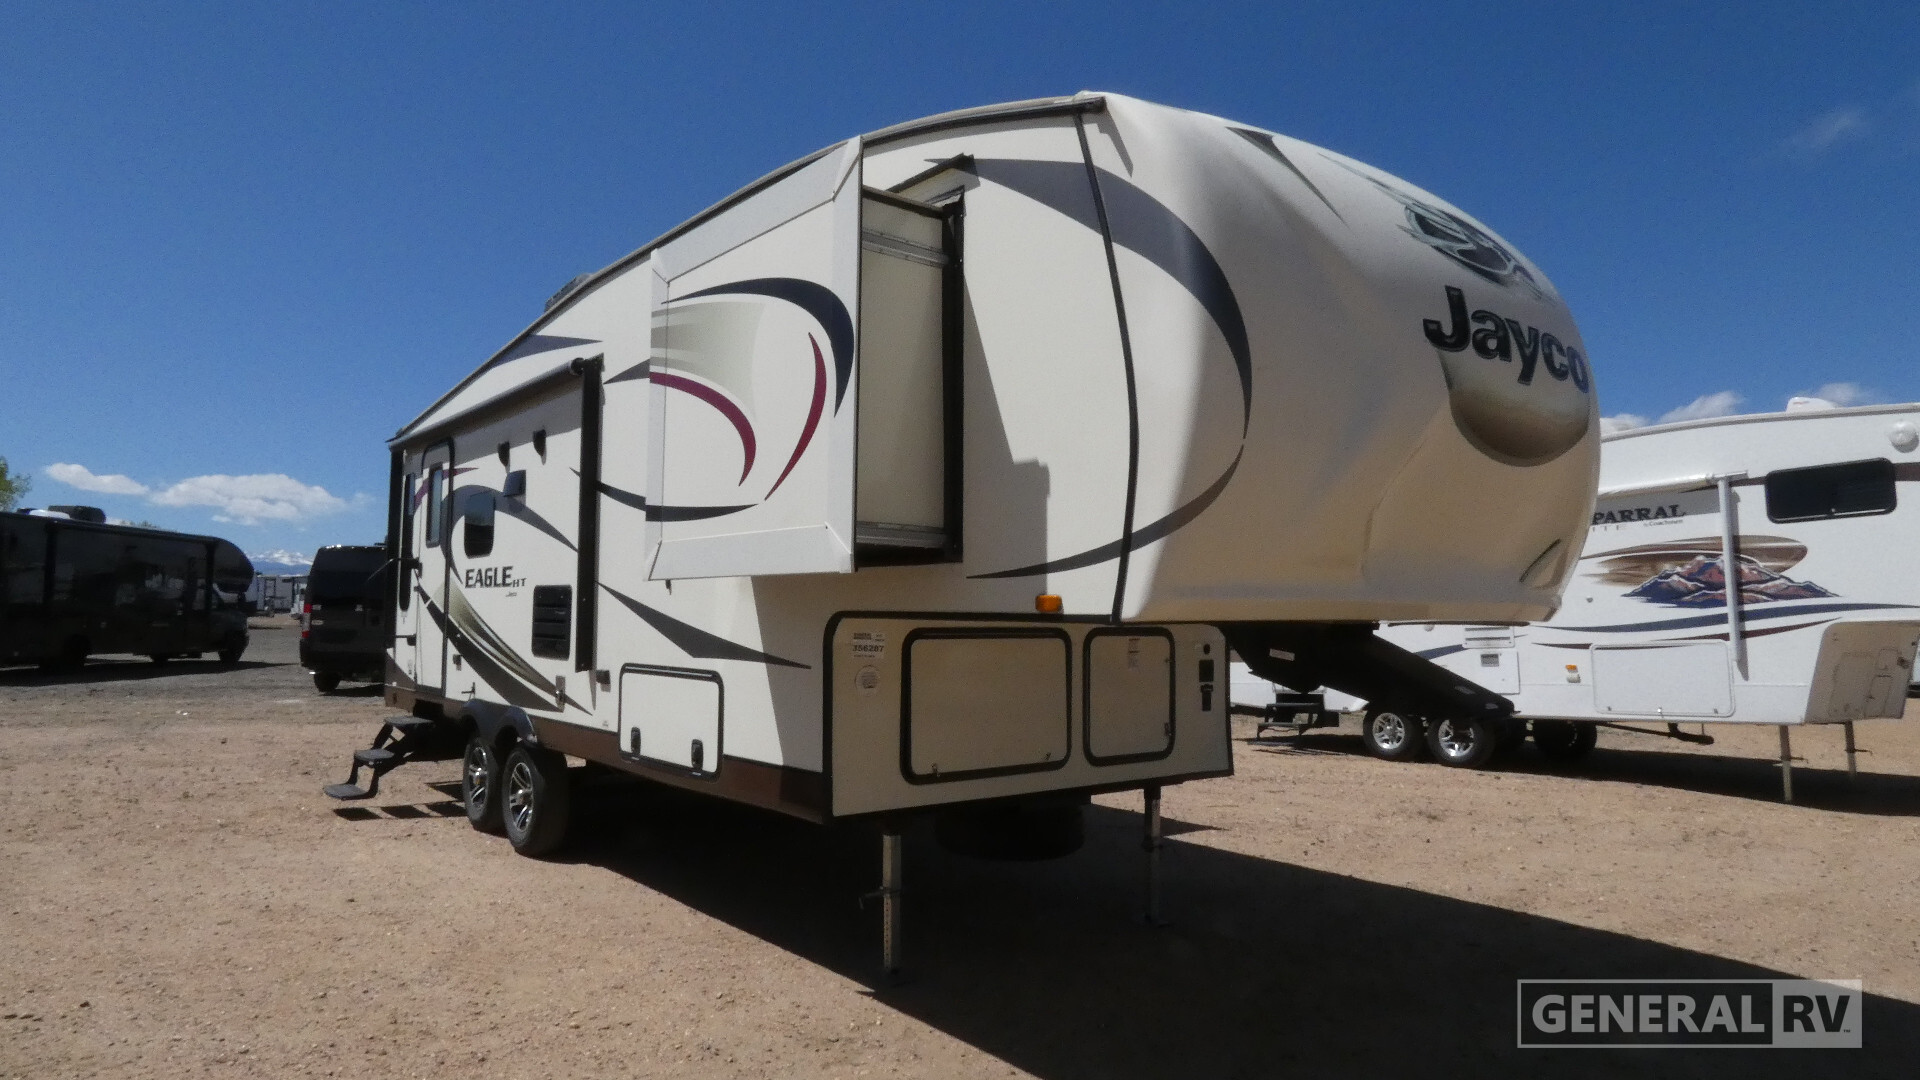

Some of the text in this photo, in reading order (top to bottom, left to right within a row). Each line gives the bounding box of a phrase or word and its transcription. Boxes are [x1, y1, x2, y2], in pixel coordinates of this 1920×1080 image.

[1423, 285, 1589, 393] Jayco
[465, 566, 527, 588] EAGLE HT
